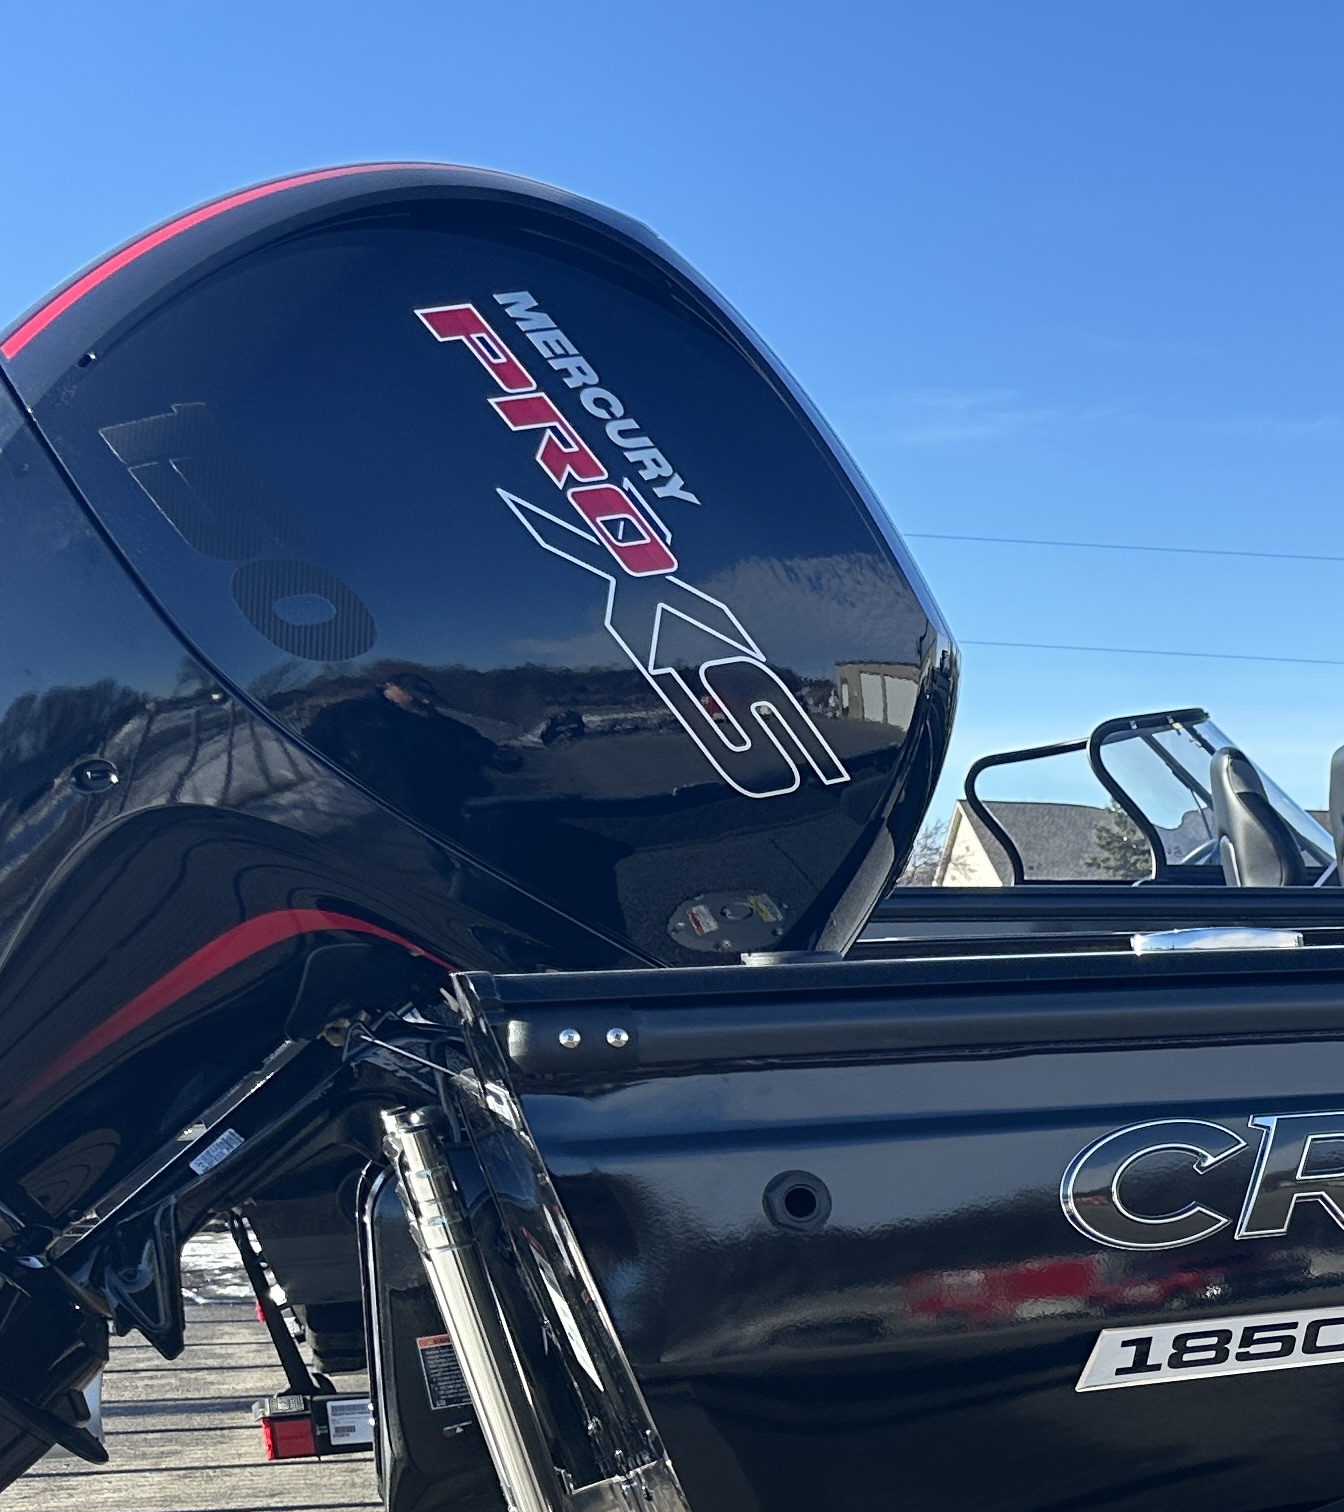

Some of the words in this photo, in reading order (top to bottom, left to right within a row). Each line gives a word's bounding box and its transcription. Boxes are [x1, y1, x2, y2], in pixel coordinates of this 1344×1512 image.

[414, 303, 678, 578] PRO
[494, 290, 702, 506] MERCURY
[496, 479, 850, 798] XS
